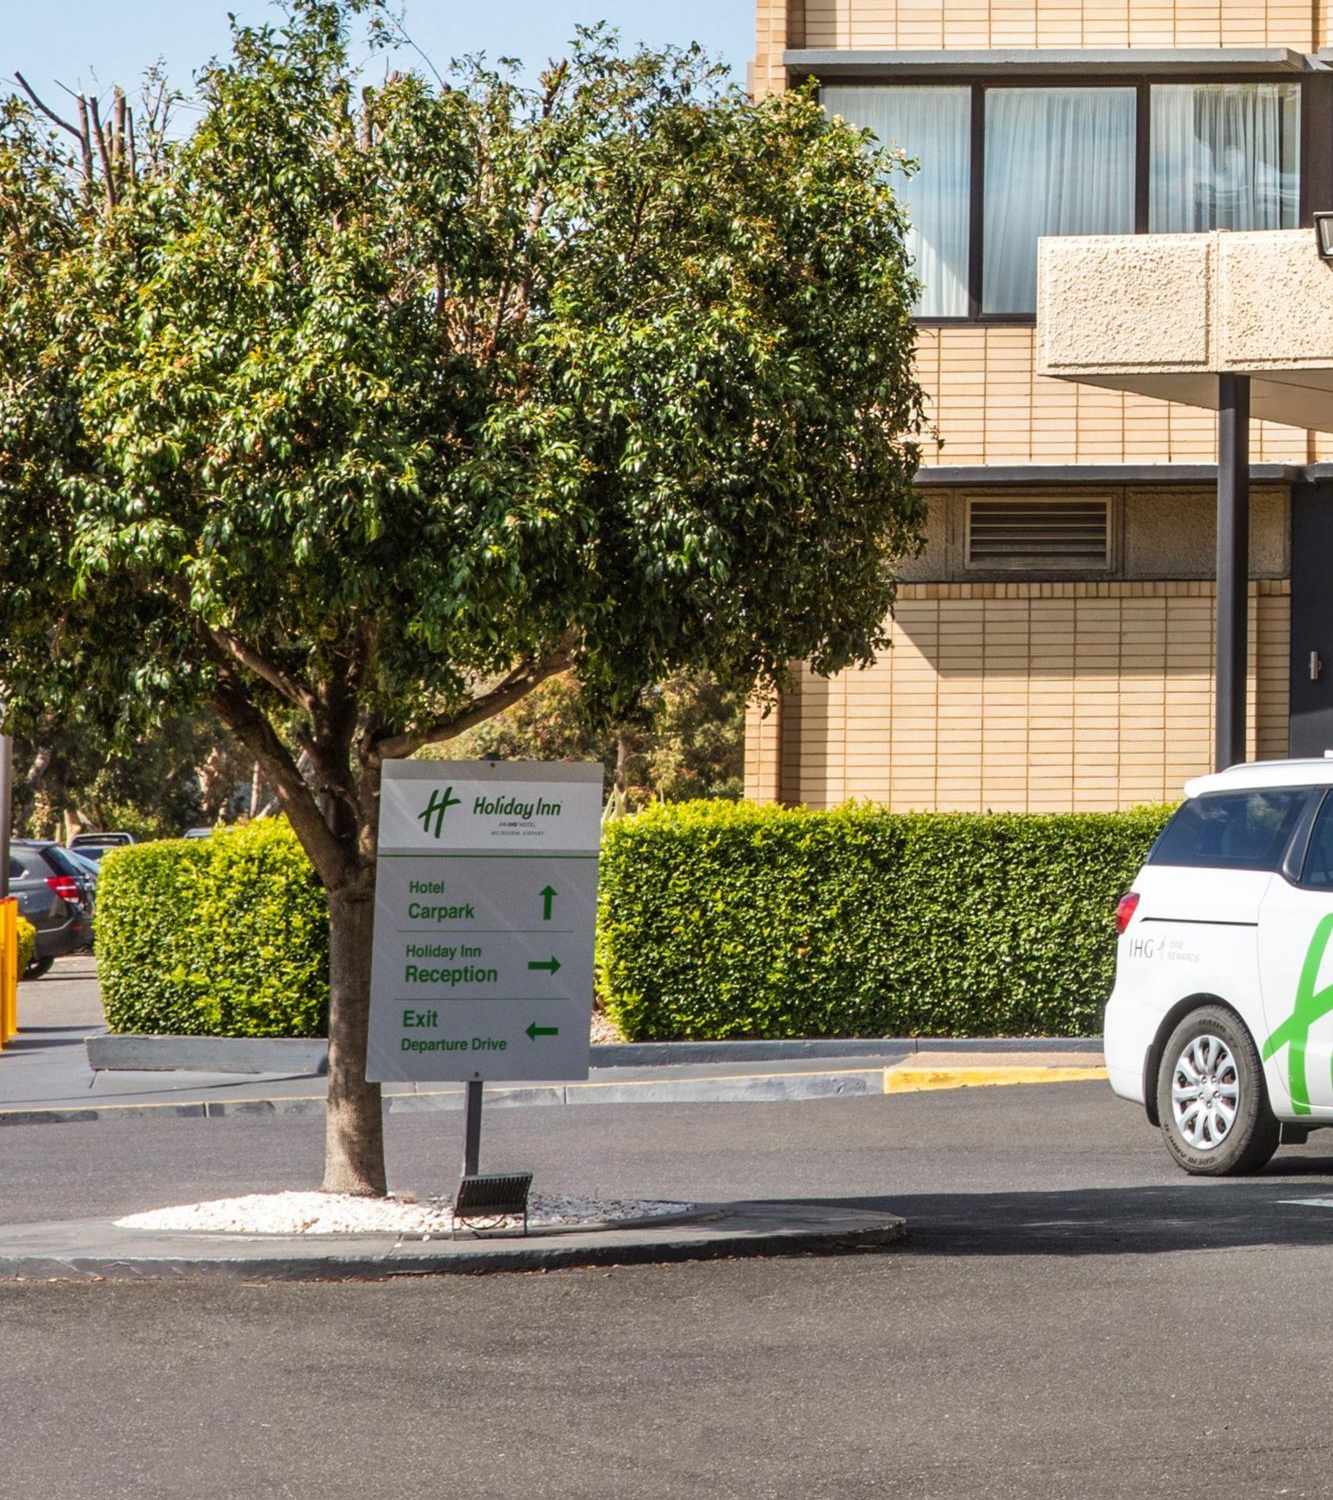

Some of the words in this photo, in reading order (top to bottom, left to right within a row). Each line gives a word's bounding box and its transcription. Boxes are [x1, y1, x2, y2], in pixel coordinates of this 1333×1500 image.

[473, 795, 534, 819] Holiday
[536, 797, 561, 816] Inn
[409, 881, 445, 894] Hotel
[408, 903, 474, 923] Carpark
[406, 945, 457, 961] Holiday
[461, 946, 482, 958] Inn
[1129, 939, 1154, 958] IHG
[1168, 940, 1184, 949] ONE
[405, 965, 498, 986] Reception
[403, 1010, 438, 1028] Exit
[401, 1038, 468, 1054] Departure
[471, 1038, 507, 1051] Drive
